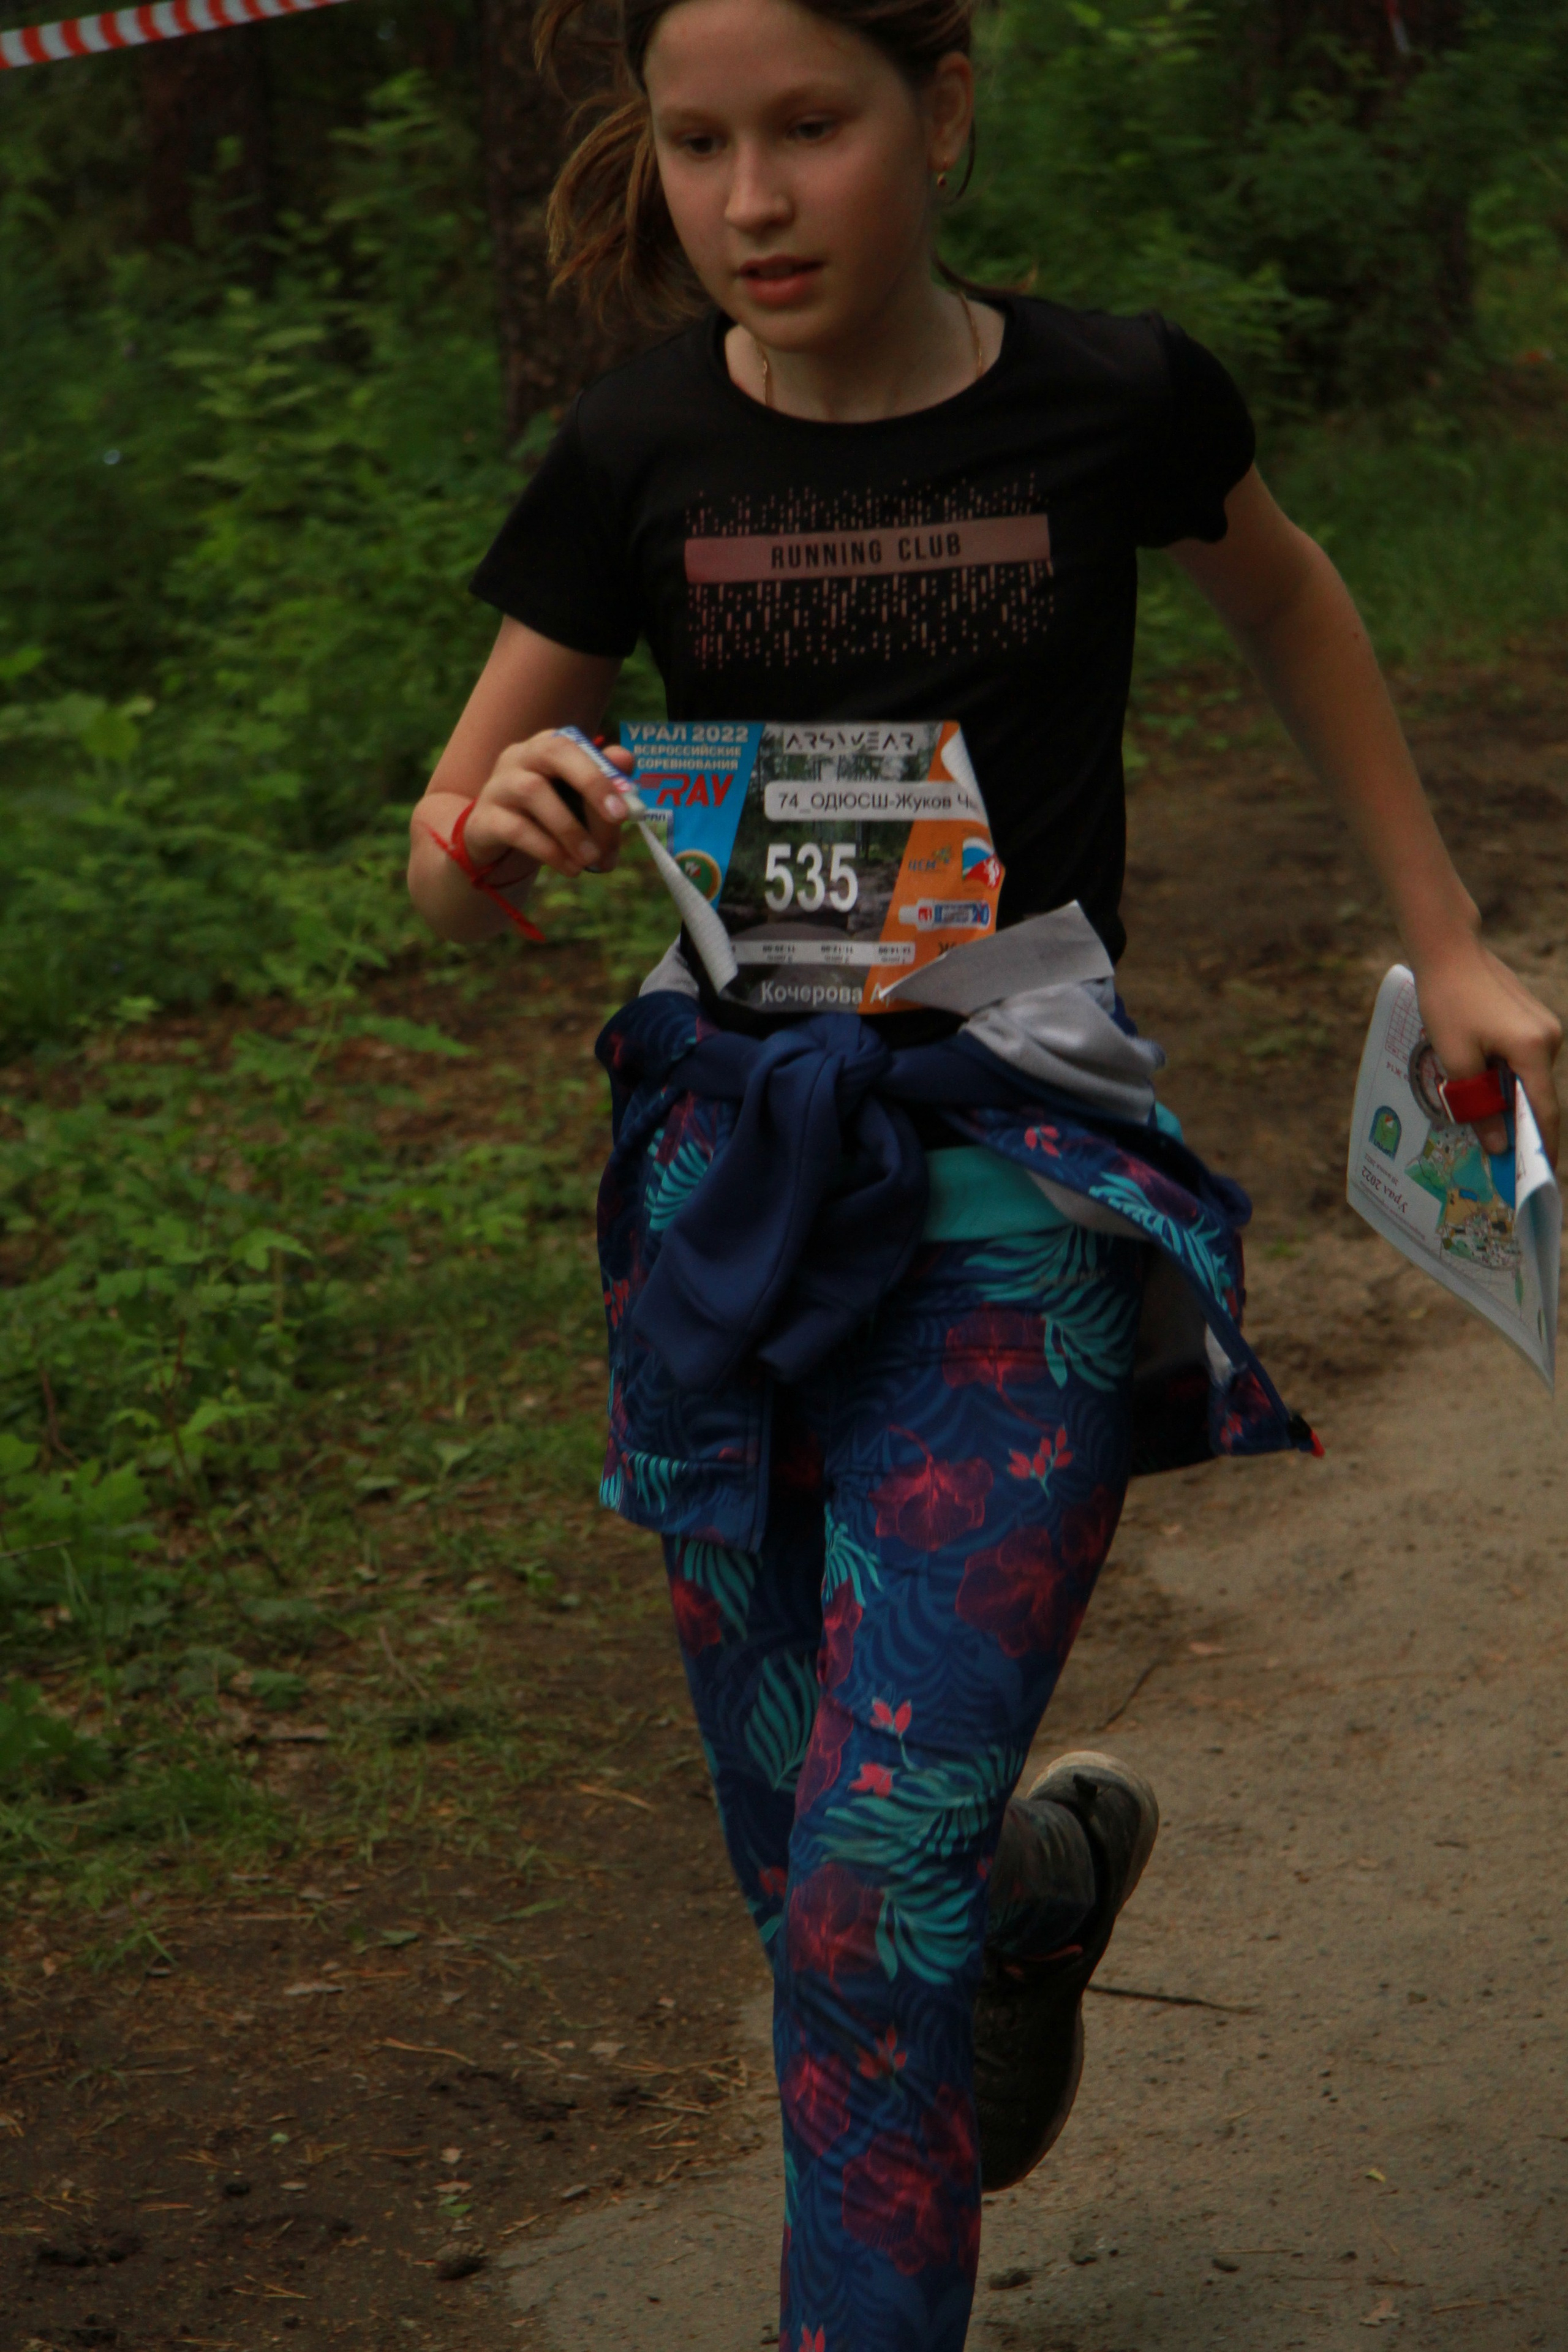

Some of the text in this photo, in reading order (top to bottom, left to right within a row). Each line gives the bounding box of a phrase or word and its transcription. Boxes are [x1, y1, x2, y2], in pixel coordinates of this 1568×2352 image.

[771, 532, 962, 570] RUNNING CLUB
[627, 724, 749, 743] УРАЛ 2022
[633, 744, 742, 757] ВСЕРОССИЙСКИЕ
[637, 758, 739, 770] СОРЕВНОВАНИЯ
[763, 843, 859, 913] 535
[761, 980, 863, 1008] Кочерова
